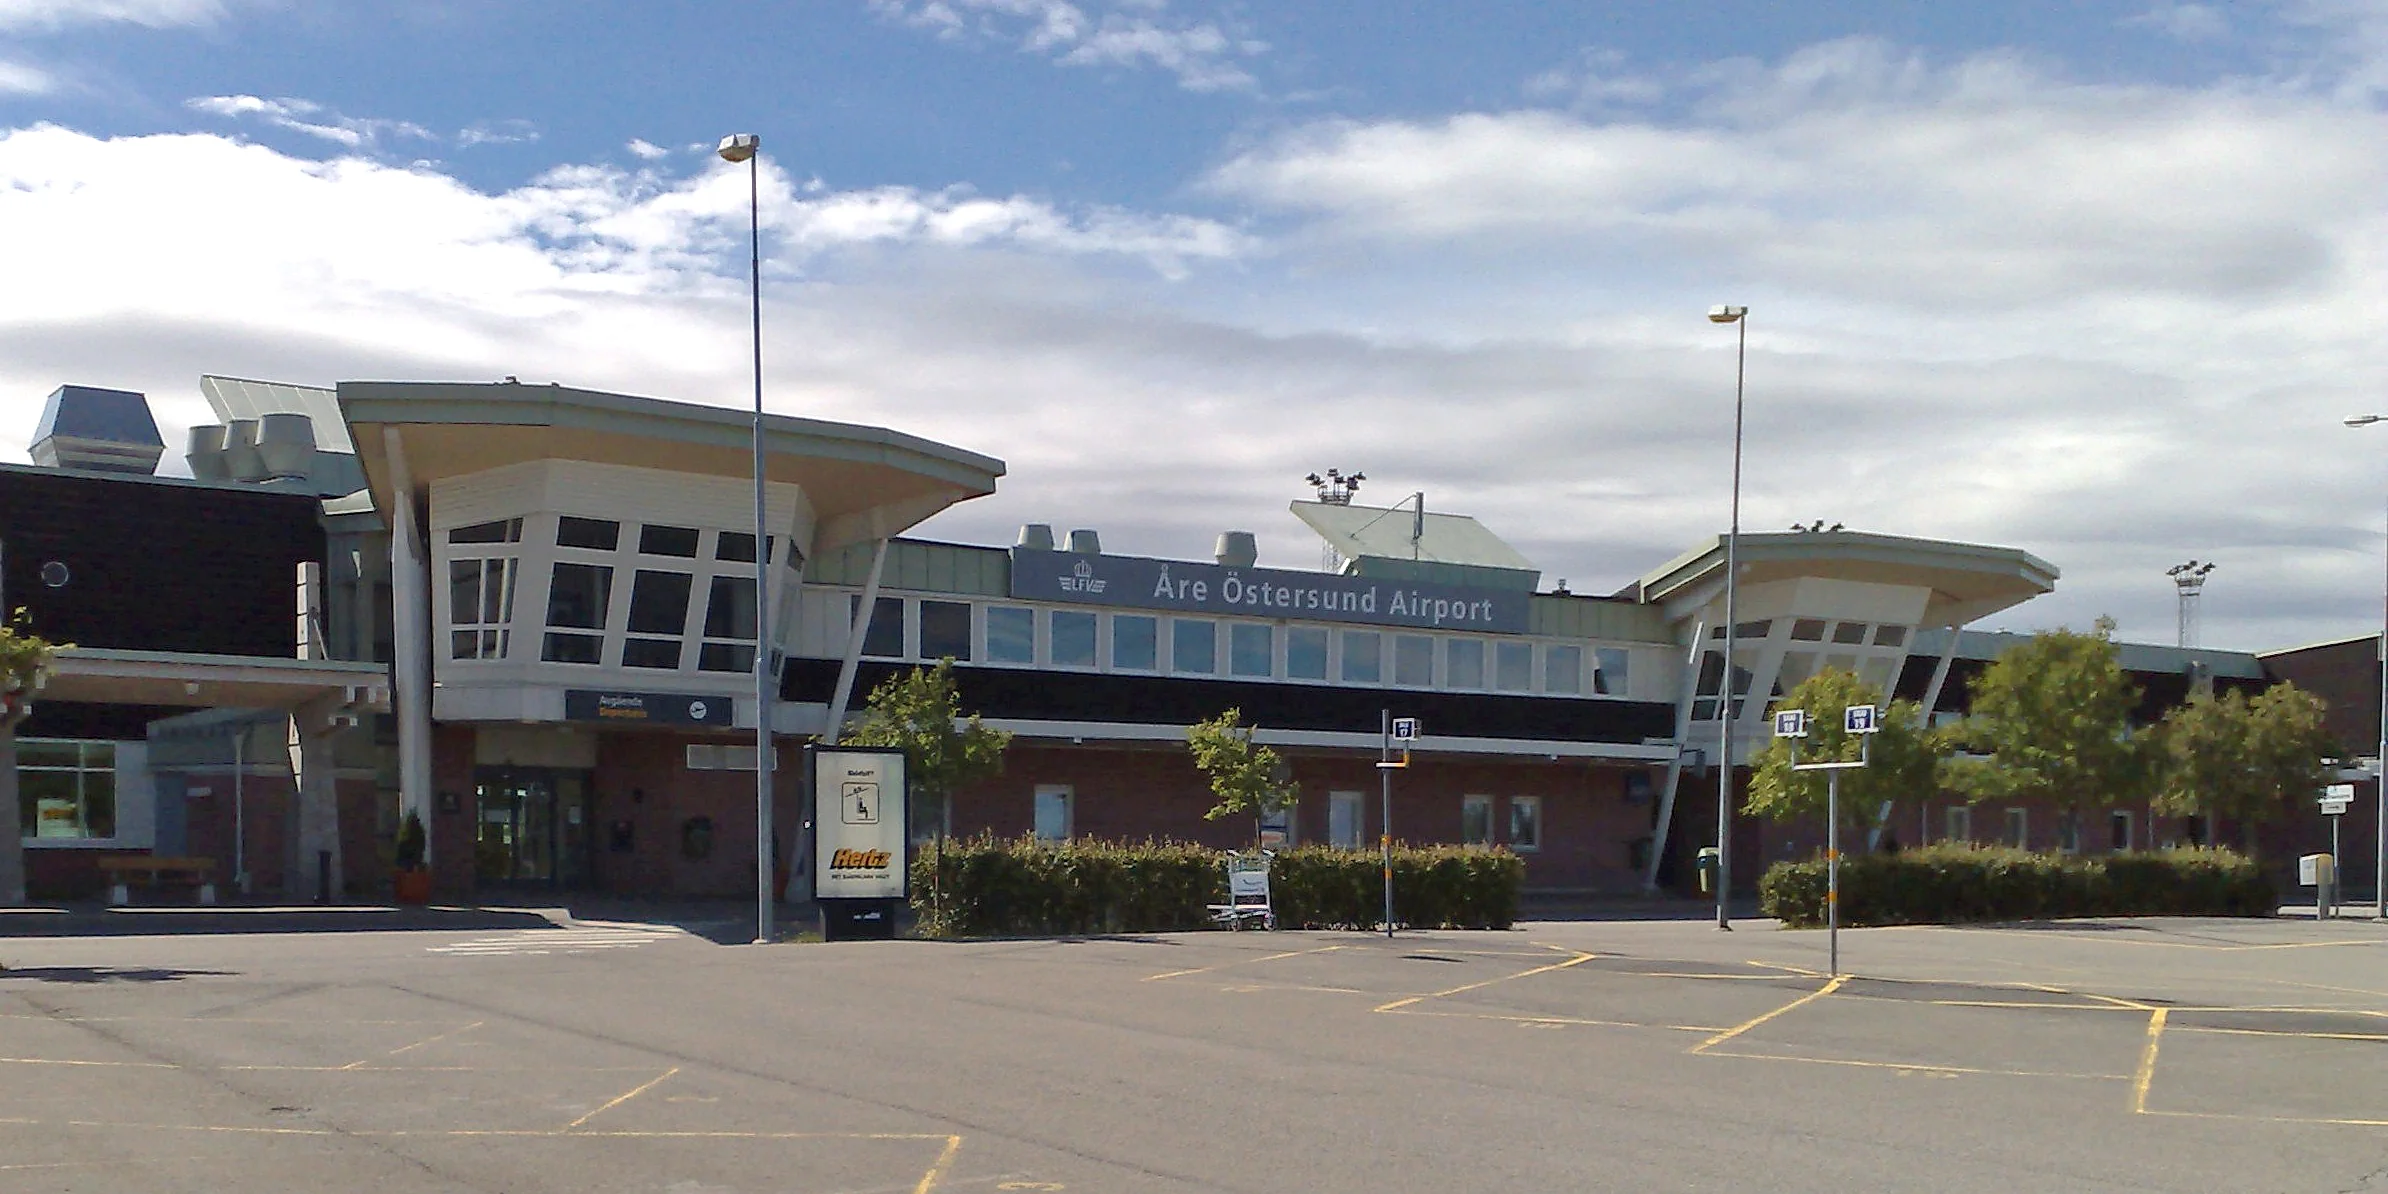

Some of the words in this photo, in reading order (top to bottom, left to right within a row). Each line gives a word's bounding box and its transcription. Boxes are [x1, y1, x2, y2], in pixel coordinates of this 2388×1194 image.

[1153, 563, 1208, 600] Åre
[1222, 571, 1376, 614] Östersund
[1389, 590, 1492, 625] Airport
[829, 847, 892, 869] Hertz
